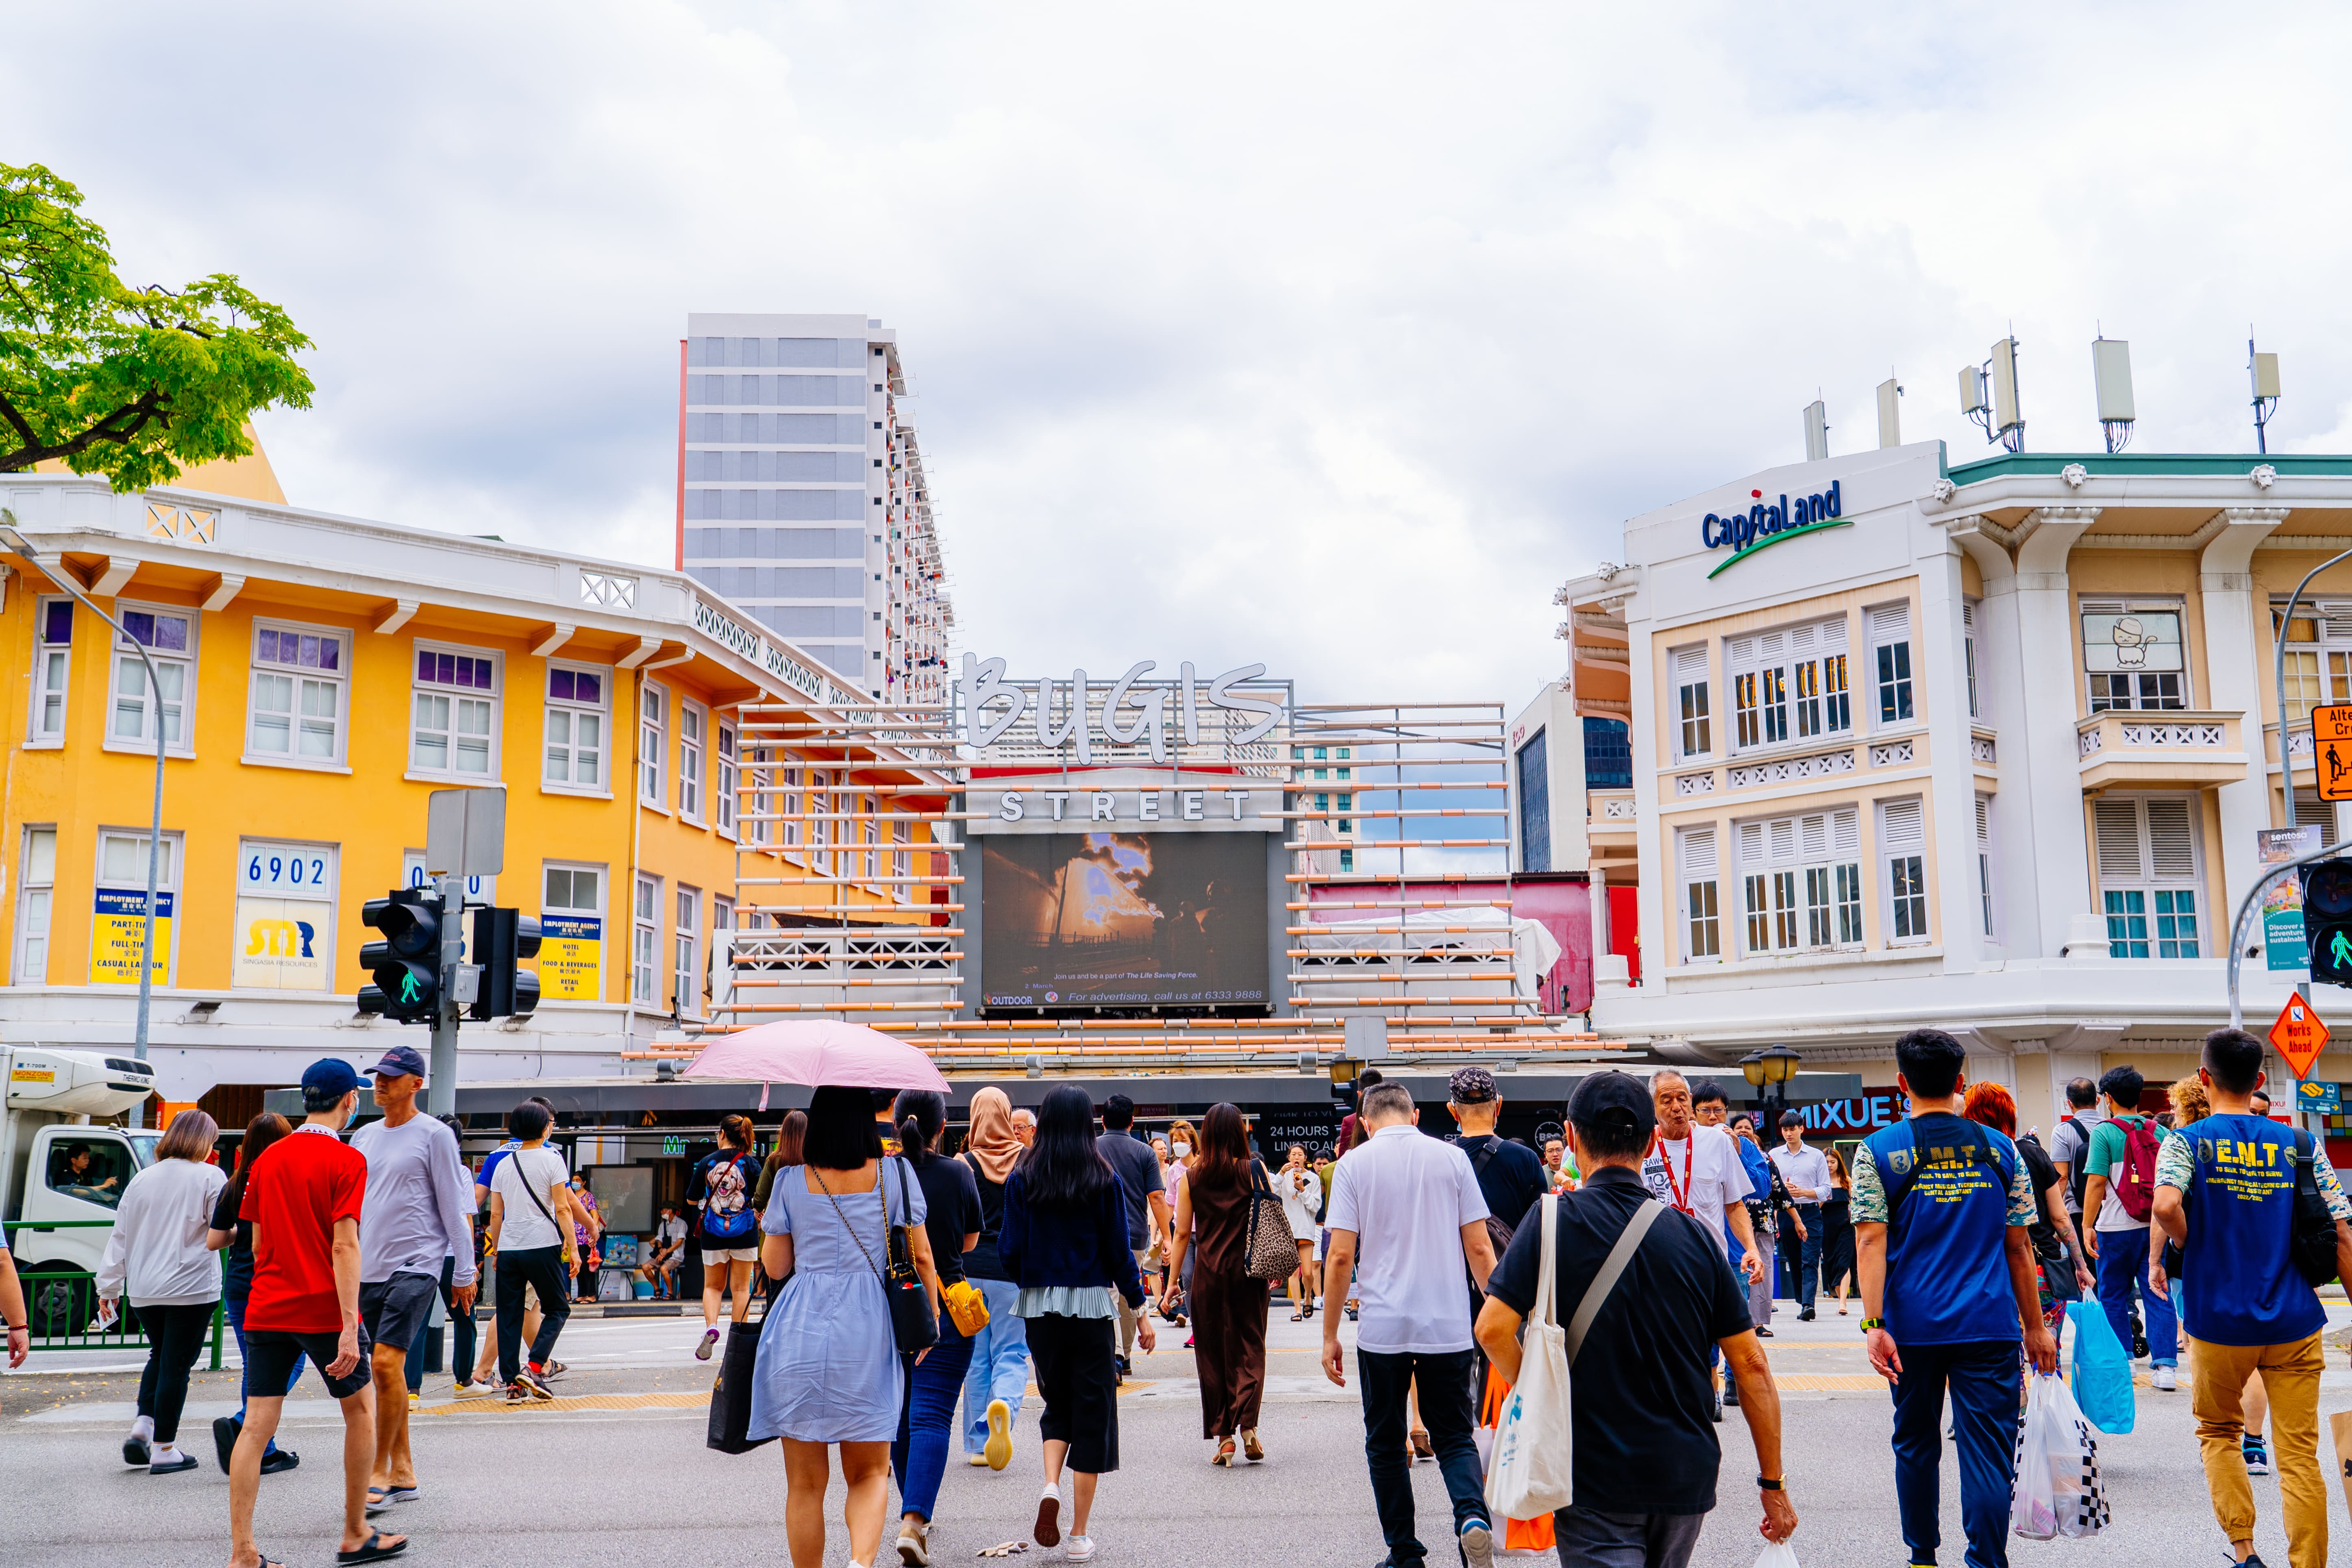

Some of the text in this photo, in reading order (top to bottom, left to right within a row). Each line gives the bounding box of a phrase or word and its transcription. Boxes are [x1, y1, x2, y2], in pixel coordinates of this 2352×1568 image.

[1702, 480, 1842, 552] CapitaLand
[1741, 657, 1848, 708] CAT CAFE
[2330, 709, 2352, 722] Alte
[2335, 723, 2352, 735] Cr
[1000, 790, 1249, 822] STREET
[2271, 832, 2308, 841] sentosa
[249, 856, 323, 884] 6902
[99, 895, 144, 903] EMPLOYMENT
[111, 920, 146, 929] PART-TI
[111, 940, 144, 948] FULL-TIM
[131, 961, 163, 969] LAUR
[243, 958, 318, 968] SINGASIA RESOURCES
[991, 996, 1033, 1005] OUTDOOR
[1069, 992, 1087, 1001] For
[1090, 992, 1150, 1002] advertising,
[1154, 992, 1173, 1000] call
[1191, 992, 1201, 1000] at
[1205, 991, 1231, 1000] 6333
[1235, 990, 1262, 999] 9888
[2287, 1024, 2311, 1037] Works
[2289, 1040, 2312, 1053] Ahead
[123, 1074, 150, 1084] THERMO KING
[1786, 1096, 1892, 1129] MIXUE
[1270, 1126, 1329, 1136] 24 HOURS
[1275, 1141, 1335, 1151] LIN TO AL
[2216, 1139, 2278, 1167] E.M.T
